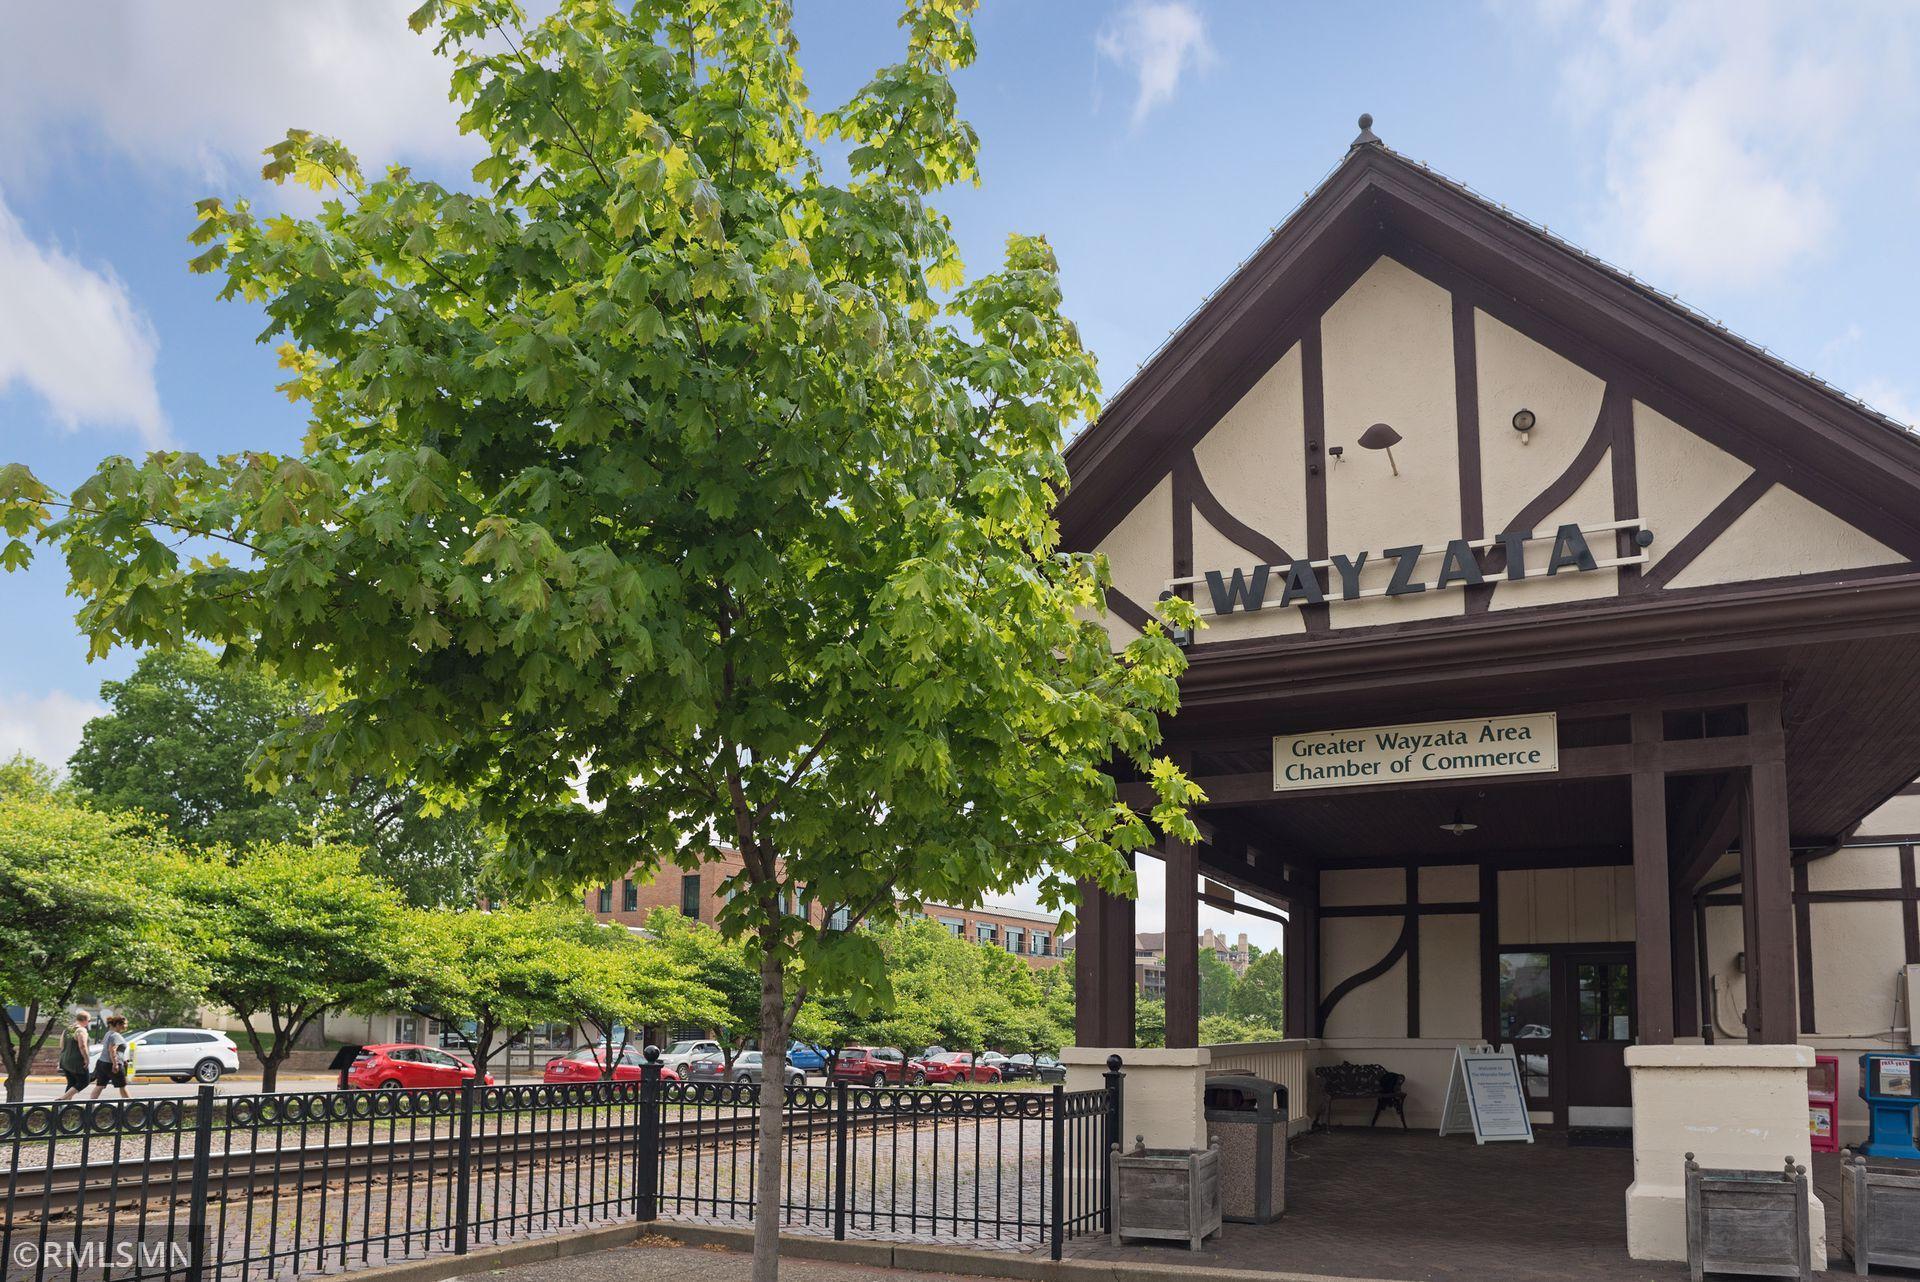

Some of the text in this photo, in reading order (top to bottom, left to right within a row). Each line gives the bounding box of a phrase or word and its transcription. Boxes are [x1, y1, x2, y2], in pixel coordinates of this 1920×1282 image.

[1205, 523, 1598, 615] WAYZATA
[1292, 725, 1532, 757] Greater Wayzata Area
[1285, 750, 1541, 781] Chamber of Commerce
